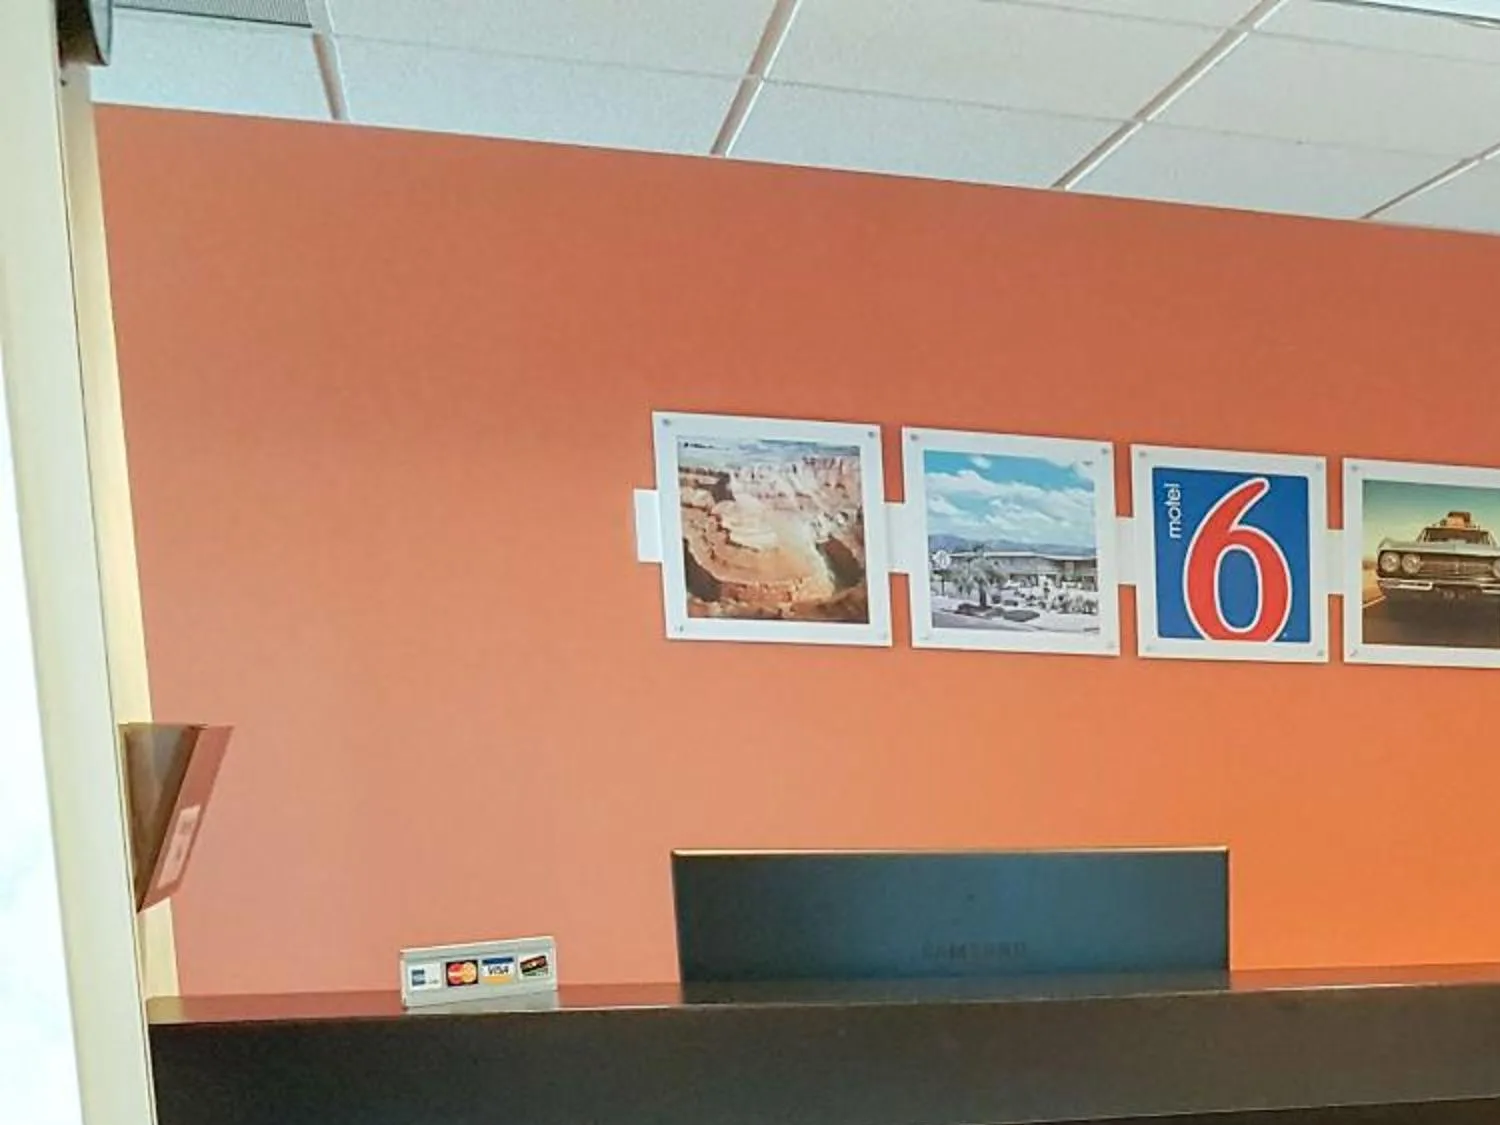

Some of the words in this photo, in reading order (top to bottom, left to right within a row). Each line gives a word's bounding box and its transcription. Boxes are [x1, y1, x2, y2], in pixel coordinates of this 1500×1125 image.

[1164, 483, 1182, 539] motel
[1183, 477, 1292, 643] 6
[487, 964, 510, 976] VISA
